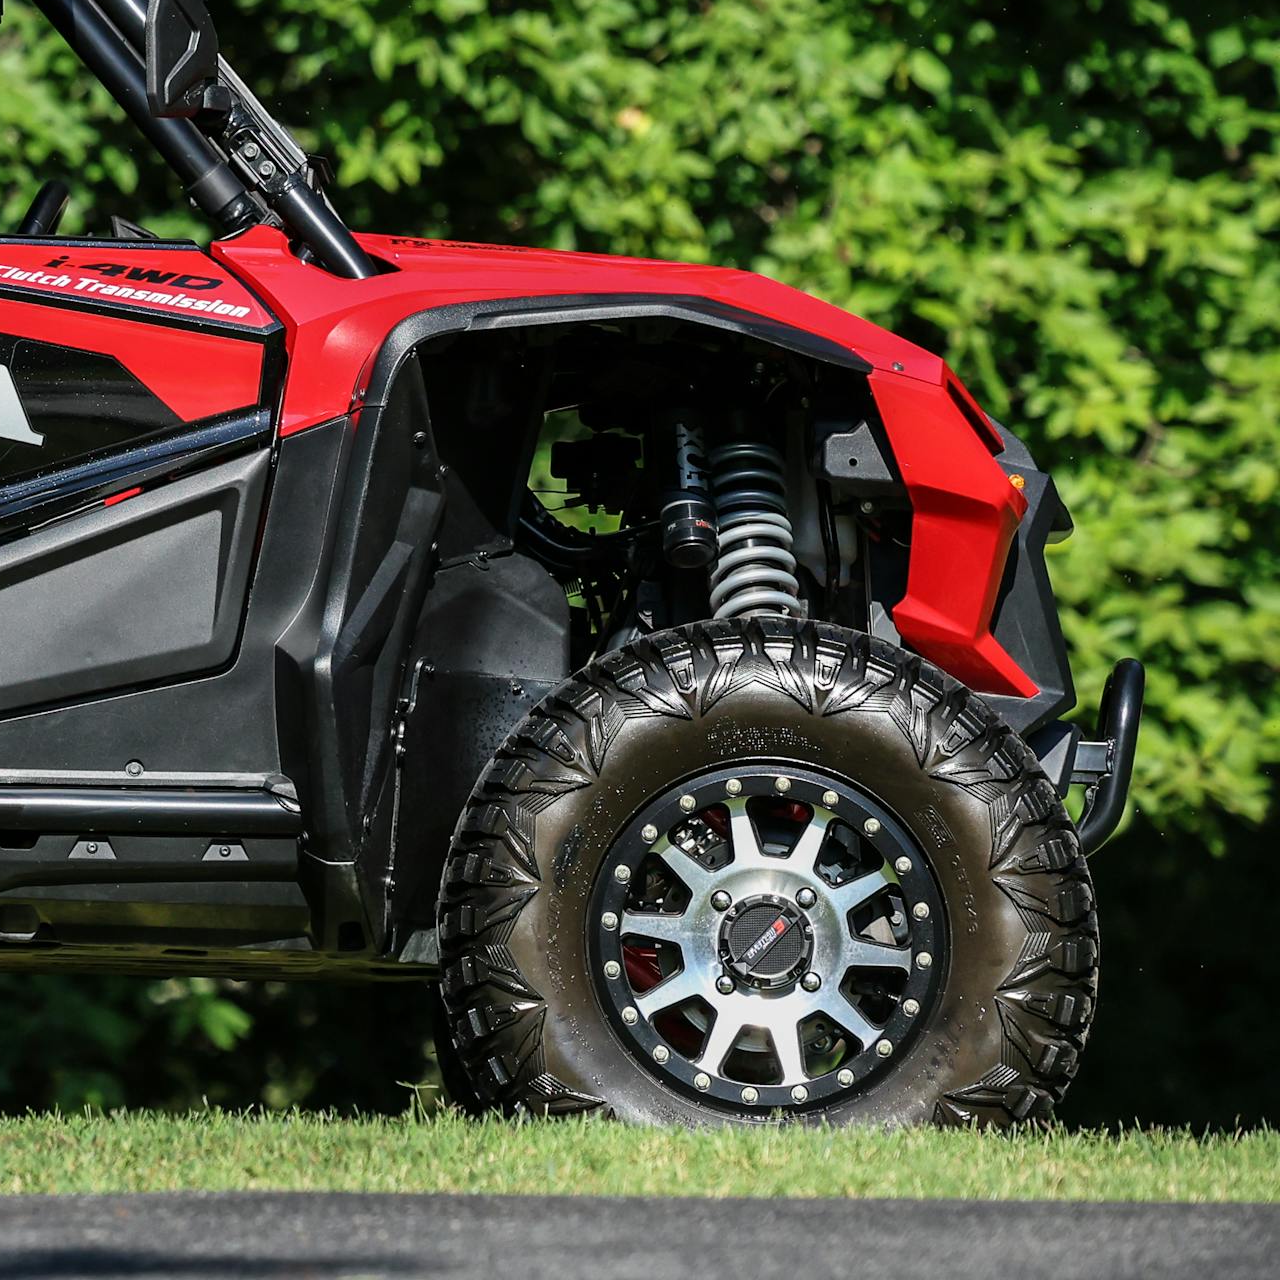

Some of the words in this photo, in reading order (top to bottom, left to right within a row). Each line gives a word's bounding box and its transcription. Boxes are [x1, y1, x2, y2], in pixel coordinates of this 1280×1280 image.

[43, 255, 225, 290] i-4WD
[73, 276, 252, 319] Transmission
[675, 423, 708, 490] FOX
